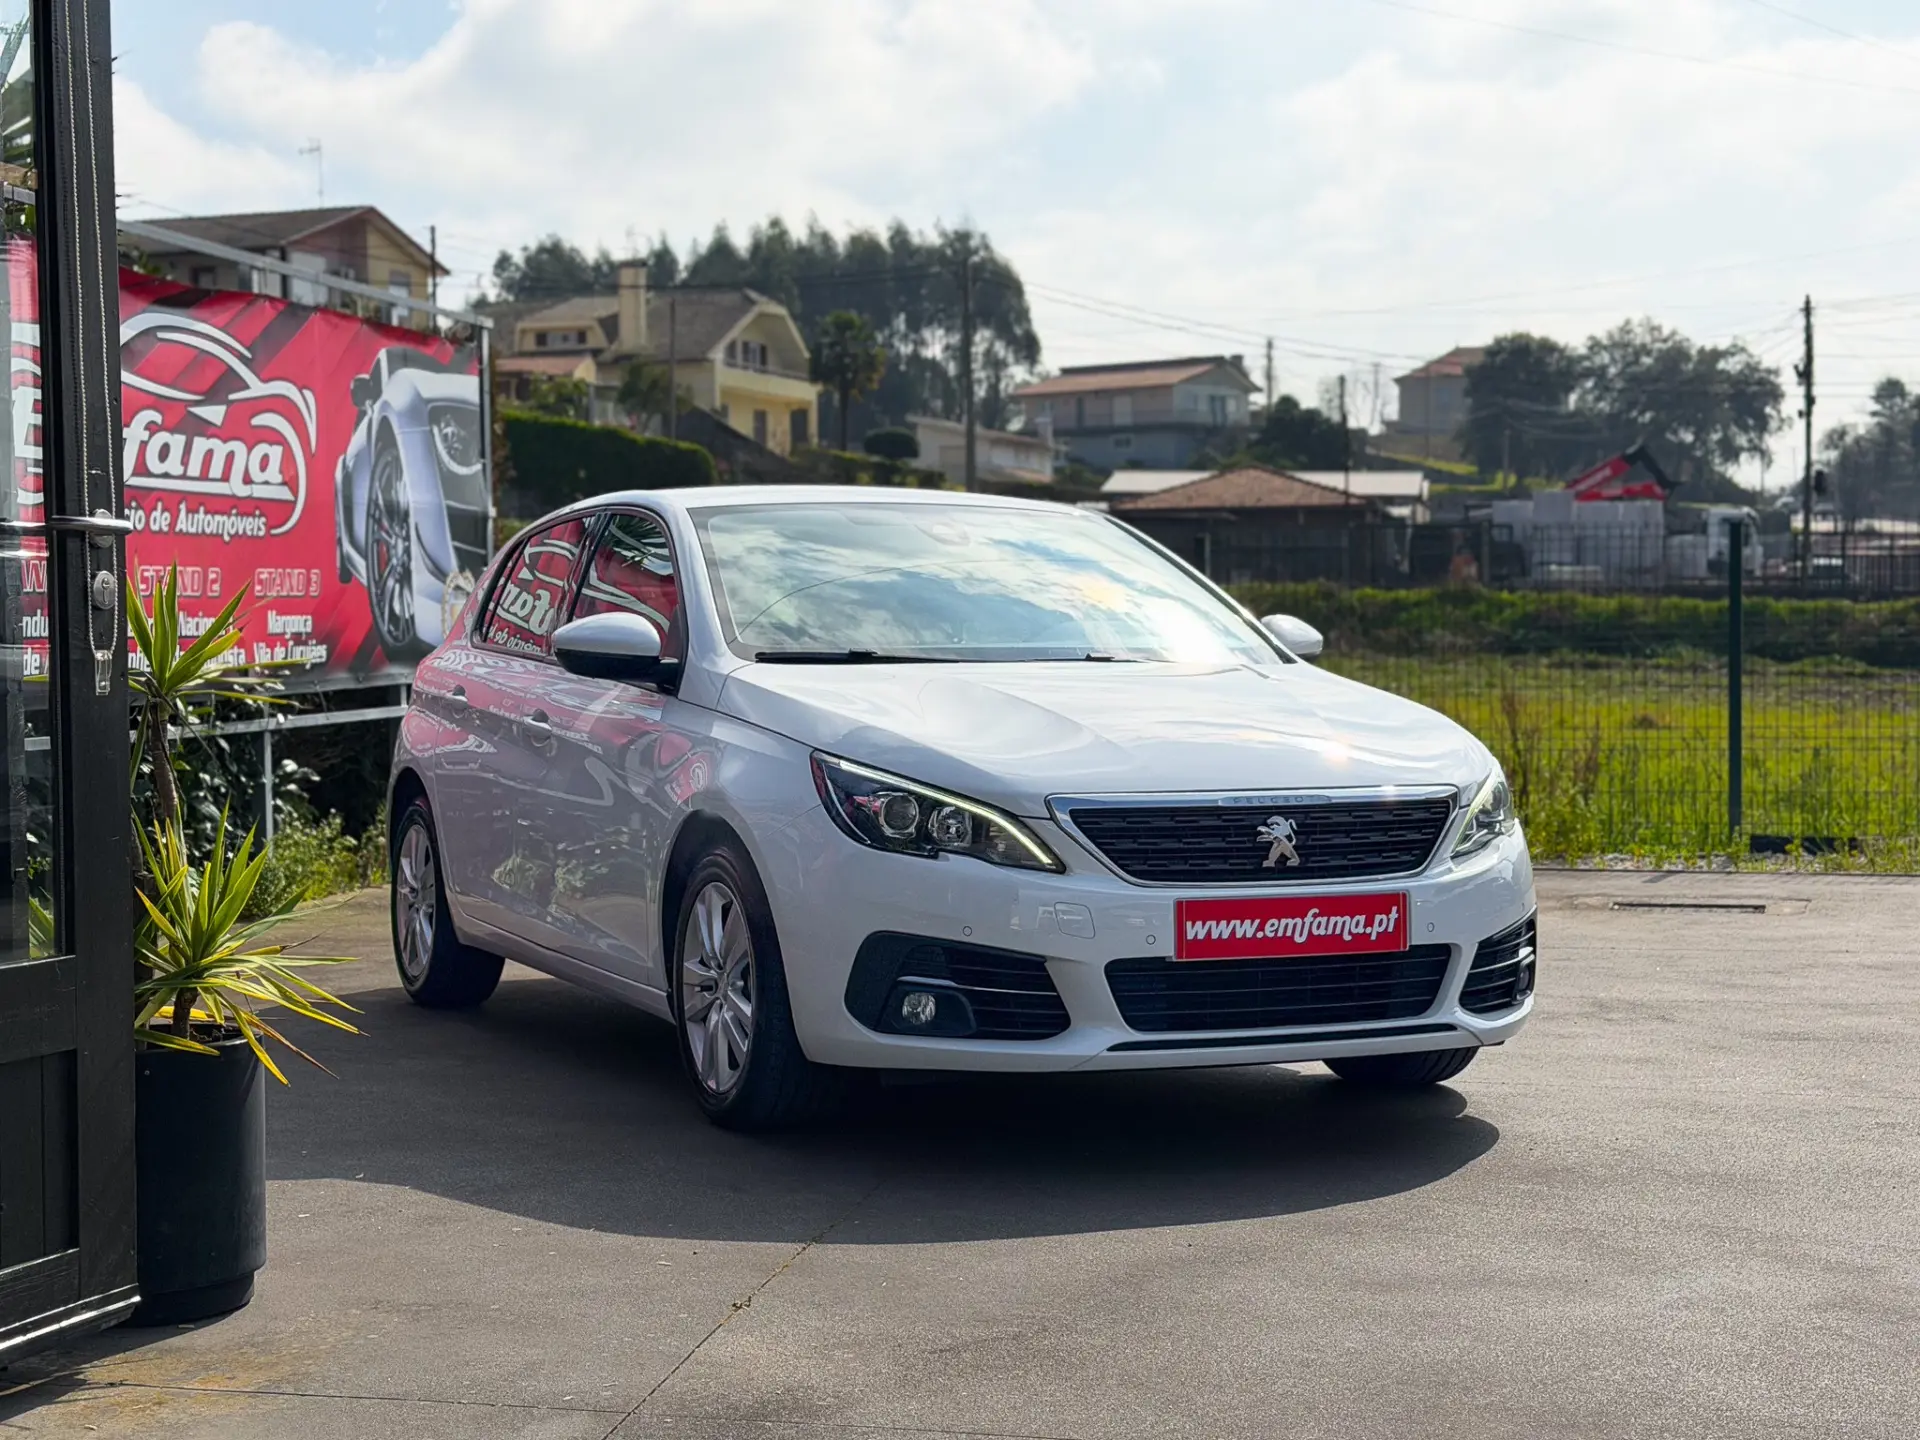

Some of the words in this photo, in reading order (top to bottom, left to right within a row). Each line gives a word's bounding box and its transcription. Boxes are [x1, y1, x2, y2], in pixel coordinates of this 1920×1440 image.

[150, 500, 171, 532] de
[175, 500, 267, 542] Automóveis
[207, 567, 221, 597] 2
[254, 568, 307, 596] STAND
[309, 568, 321, 596] 3
[1186, 906, 1398, 943] www.emfama.pt
